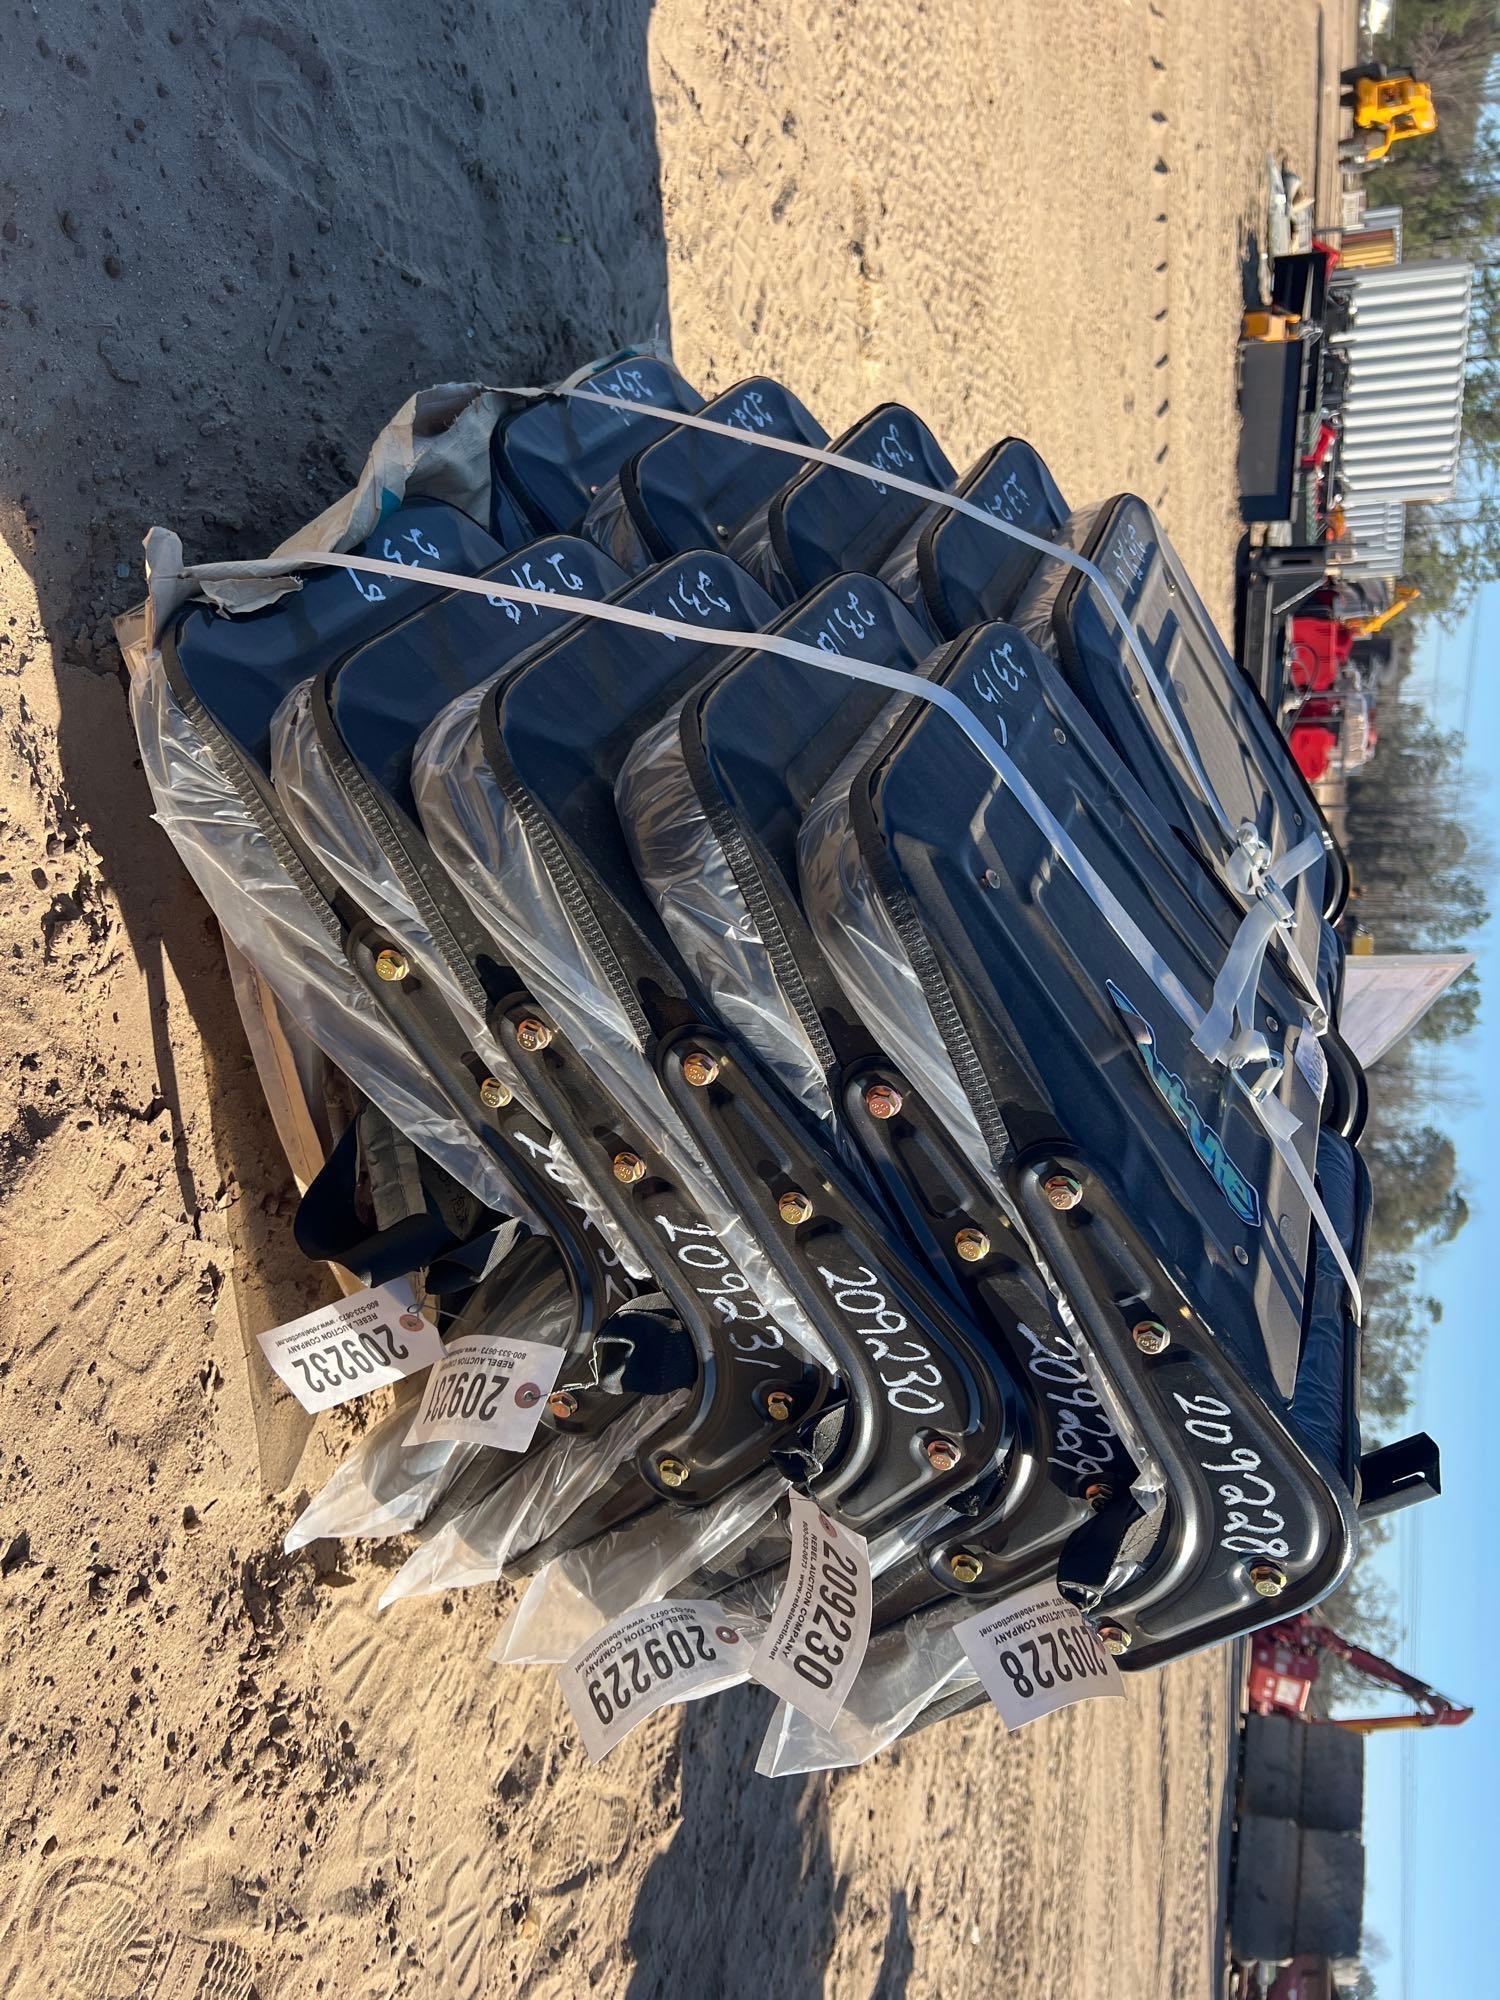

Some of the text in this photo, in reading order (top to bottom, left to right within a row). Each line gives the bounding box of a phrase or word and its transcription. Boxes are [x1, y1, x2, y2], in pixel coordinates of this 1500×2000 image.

[347, 528, 440, 602] 239
[973, 642, 1028, 704] 2315
[288, 1313, 378, 1354] REBEL AUCTION COMPANY
[291, 1324, 409, 1393] 209232
[816, 1265, 945, 1415] 209230
[486, 1358, 515, 1369] REBEL
[423, 1371, 510, 1425] 209231
[1017, 1321, 1117, 1475] 209229
[1172, 1391, 1290, 1557] 209228
[804, 1563, 817, 1607] AUCTION
[624, 1619, 665, 1644] AUCTION
[768, 1574, 804, 1661] www.rebelauction.net
[782, 1607, 808, 1659] COMPANY
[793, 1539, 858, 1690] 209230
[979, 1600, 1051, 1638] www.rebelauction.net
[994, 1620, 1037, 1645] COMPANY
[1036, 1612, 1066, 1627] AUCTION
[574, 1617, 645, 1674] www.rebelauction.net
[585, 1641, 623, 1677] COMPANY
[1000, 1625, 1108, 1698] 209228
[588, 1625, 717, 1725] 209229
